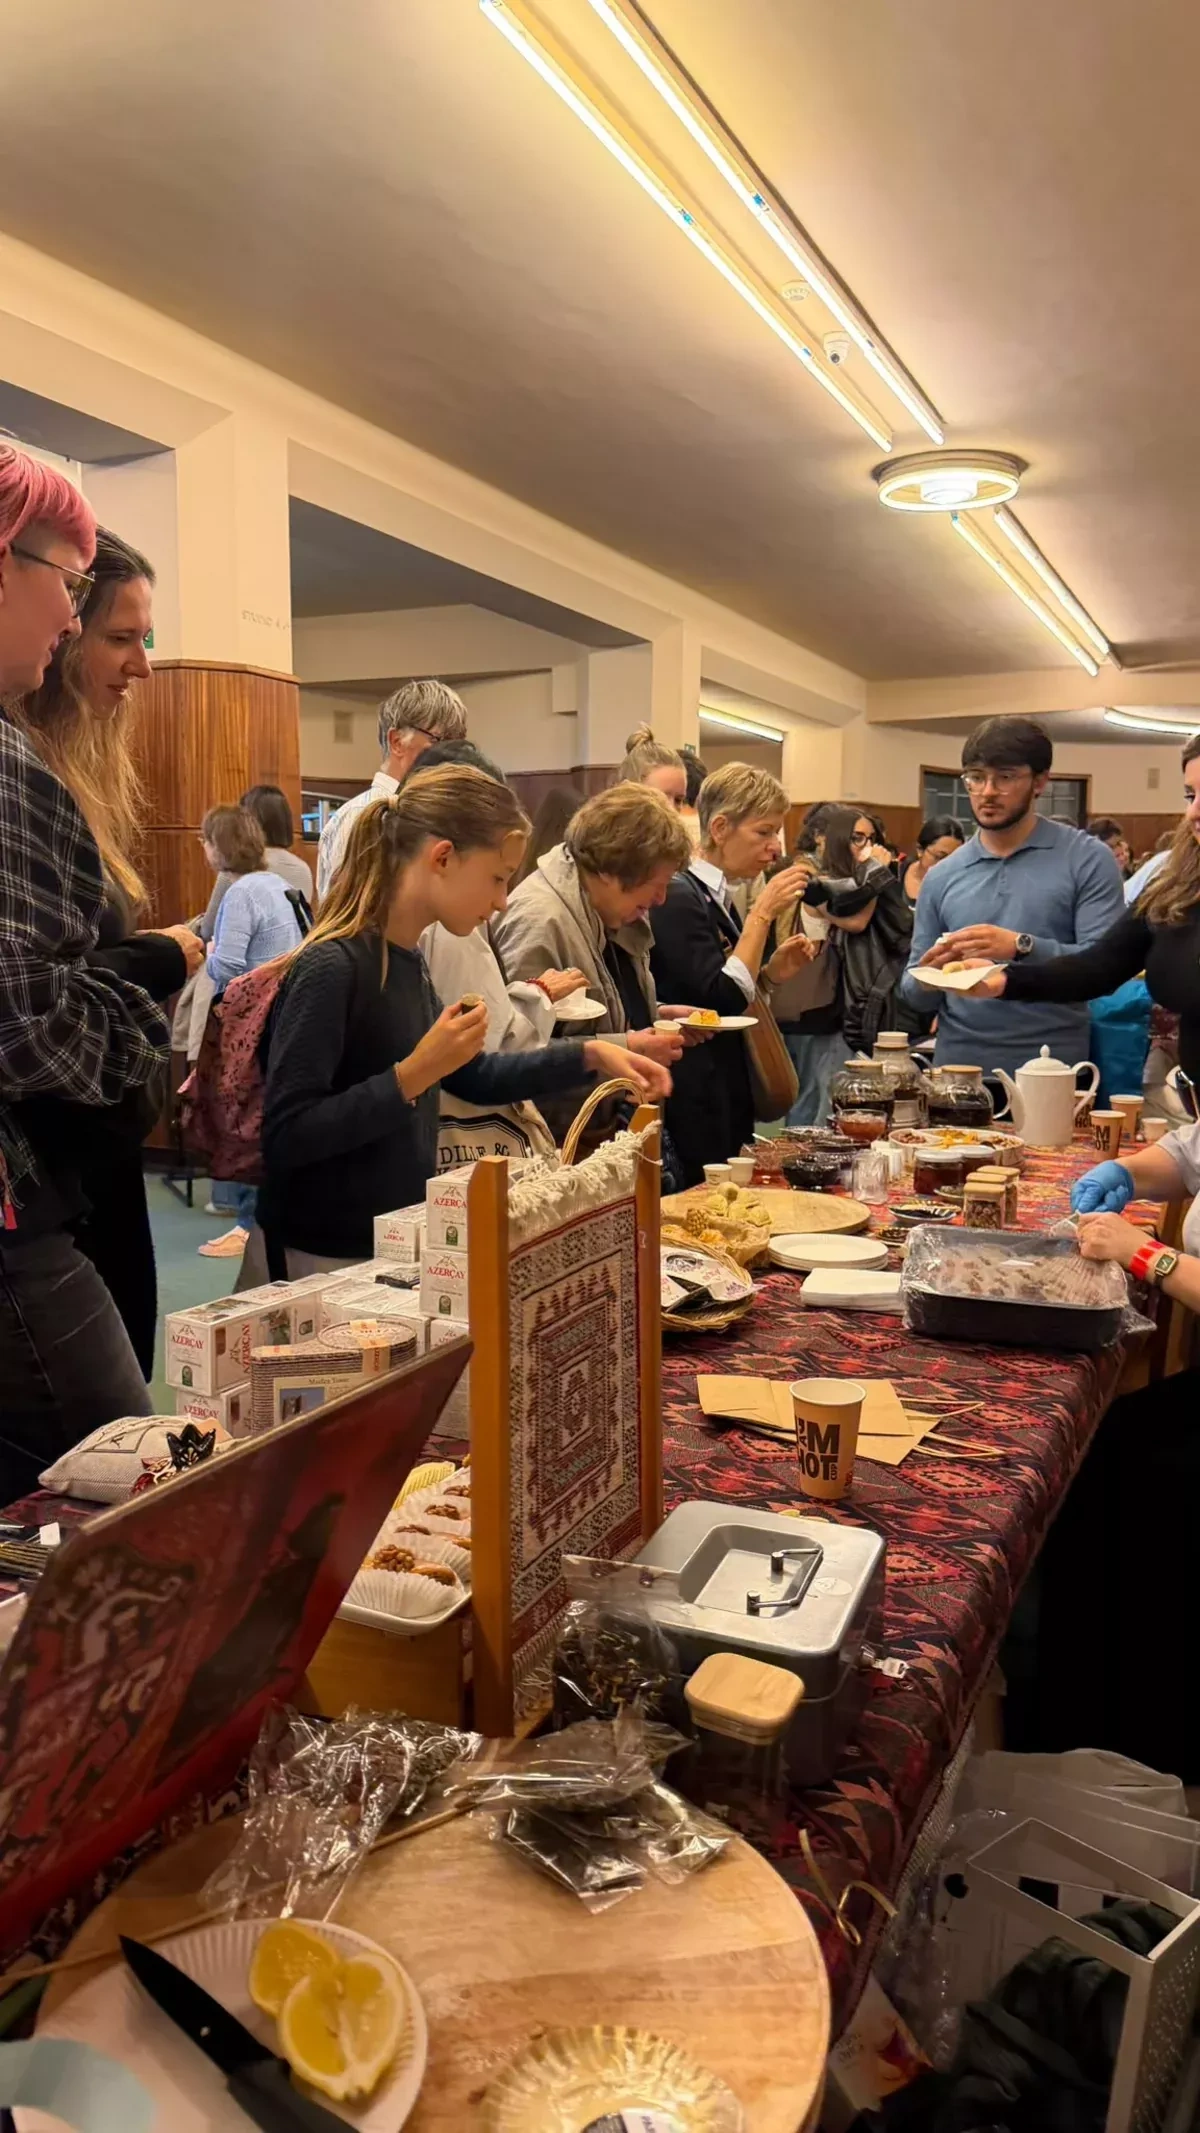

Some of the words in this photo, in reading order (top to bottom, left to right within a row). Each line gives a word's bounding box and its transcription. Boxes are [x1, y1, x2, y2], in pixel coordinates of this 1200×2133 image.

[439, 1145, 486, 1164] DILLE
[433, 1197, 467, 1208] AZERÇA
[427, 1266, 465, 1279] AZERÇAY
[172, 1335, 204, 1349] AZERÇAY
